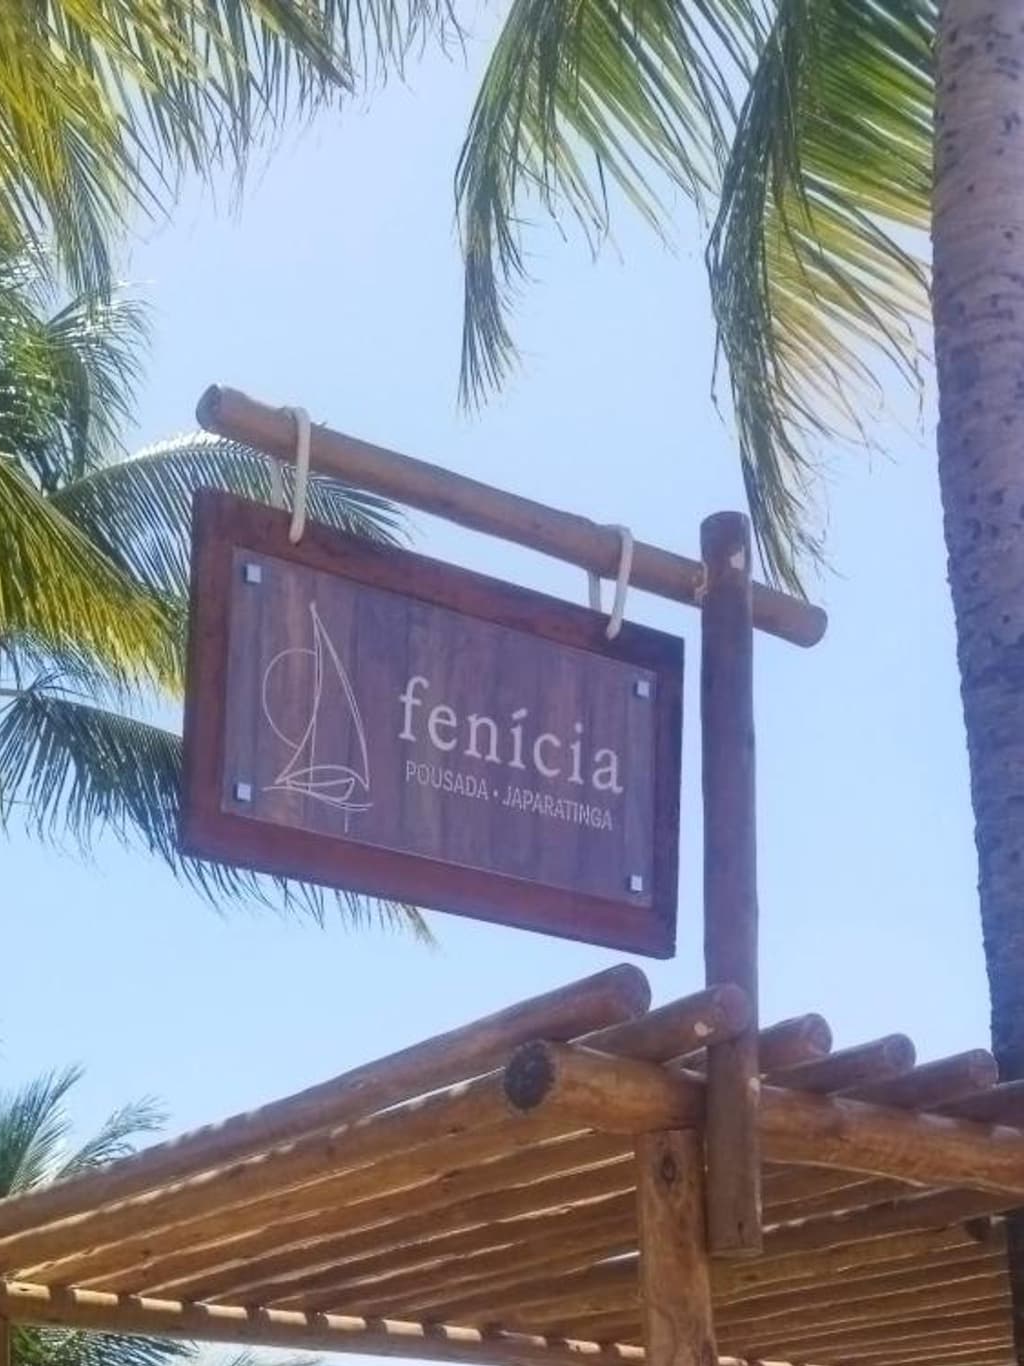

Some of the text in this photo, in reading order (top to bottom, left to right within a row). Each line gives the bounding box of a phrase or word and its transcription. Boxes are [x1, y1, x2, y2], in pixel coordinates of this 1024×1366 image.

[398, 675, 623, 794] fenícia
[405, 760, 613, 830] POUSADA JAPARATINGA
